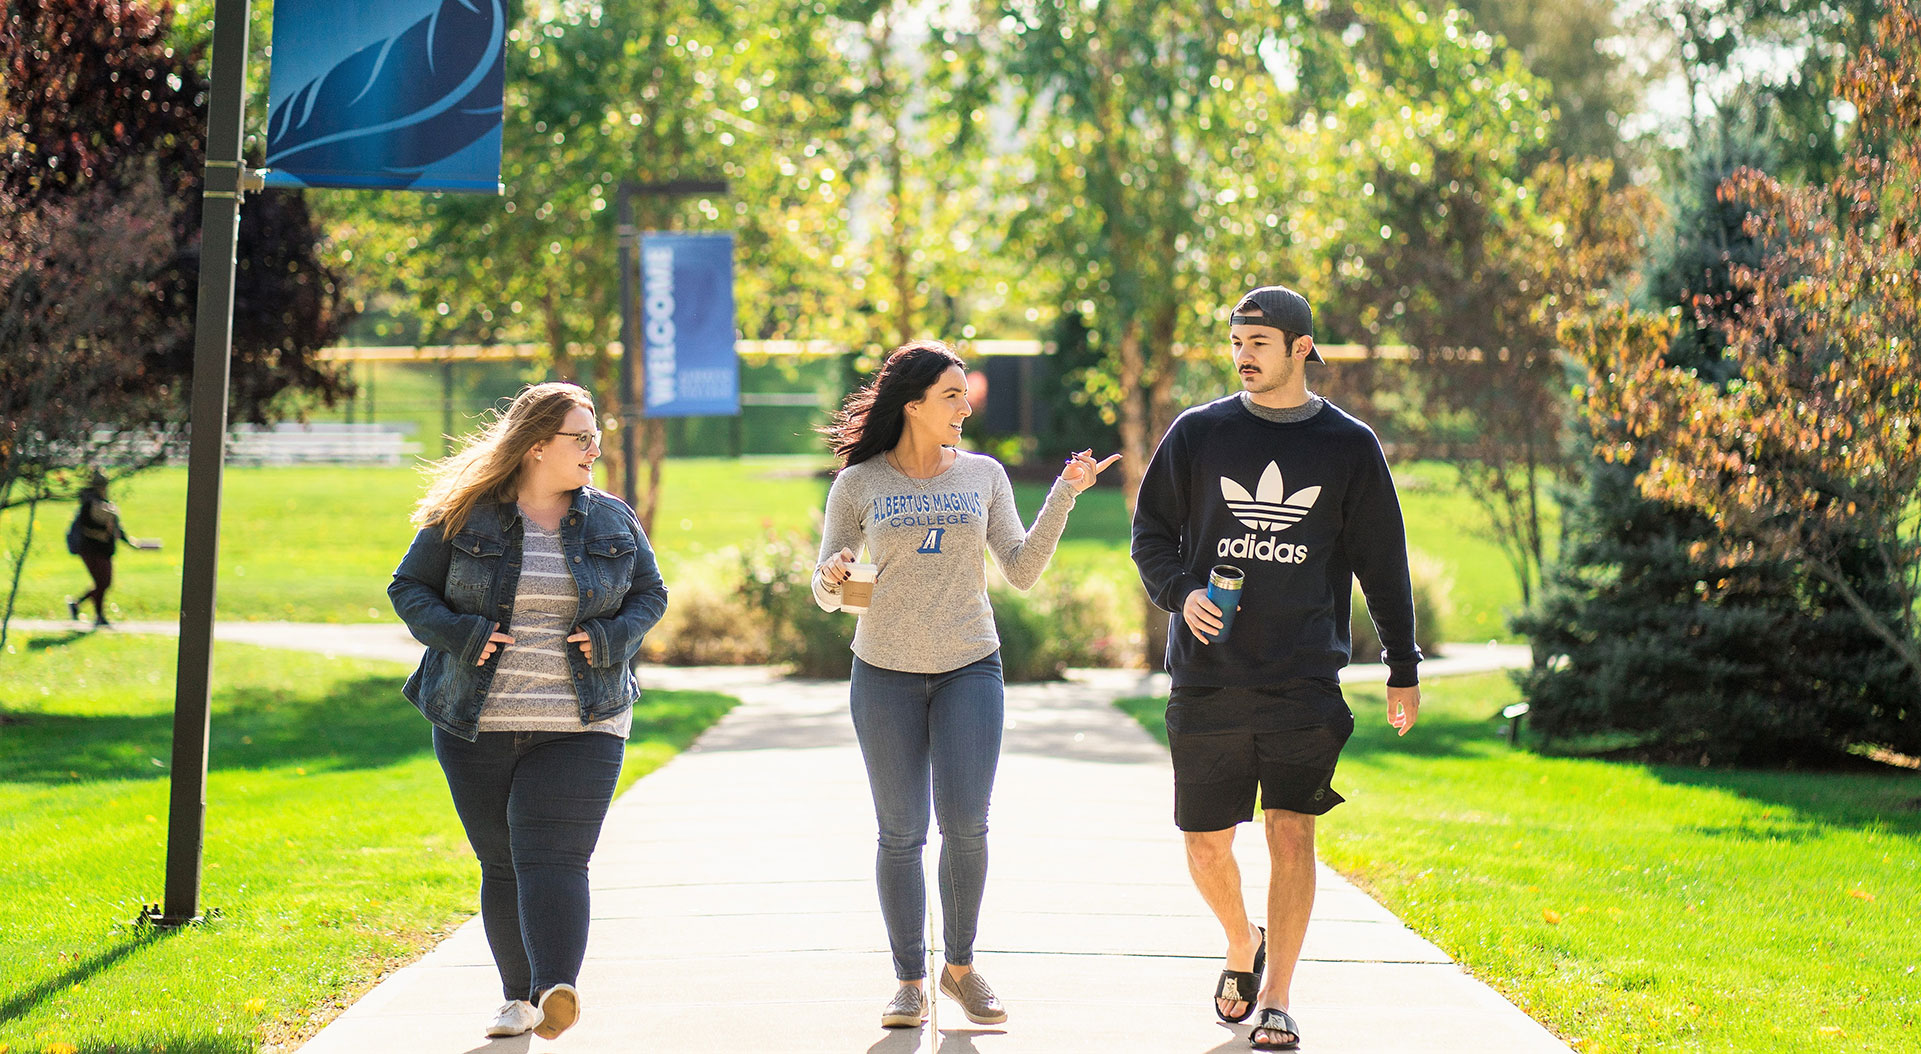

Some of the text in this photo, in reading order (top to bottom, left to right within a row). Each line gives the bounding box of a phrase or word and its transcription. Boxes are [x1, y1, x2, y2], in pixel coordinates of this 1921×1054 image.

[646, 246, 676, 407] WELCOME
[873, 491, 982, 526] ALBERTUS MAGNUS
[890, 514, 969, 528] COLLEGE
[916, 527, 946, 554] A
[1217, 533, 1308, 564] adidas
